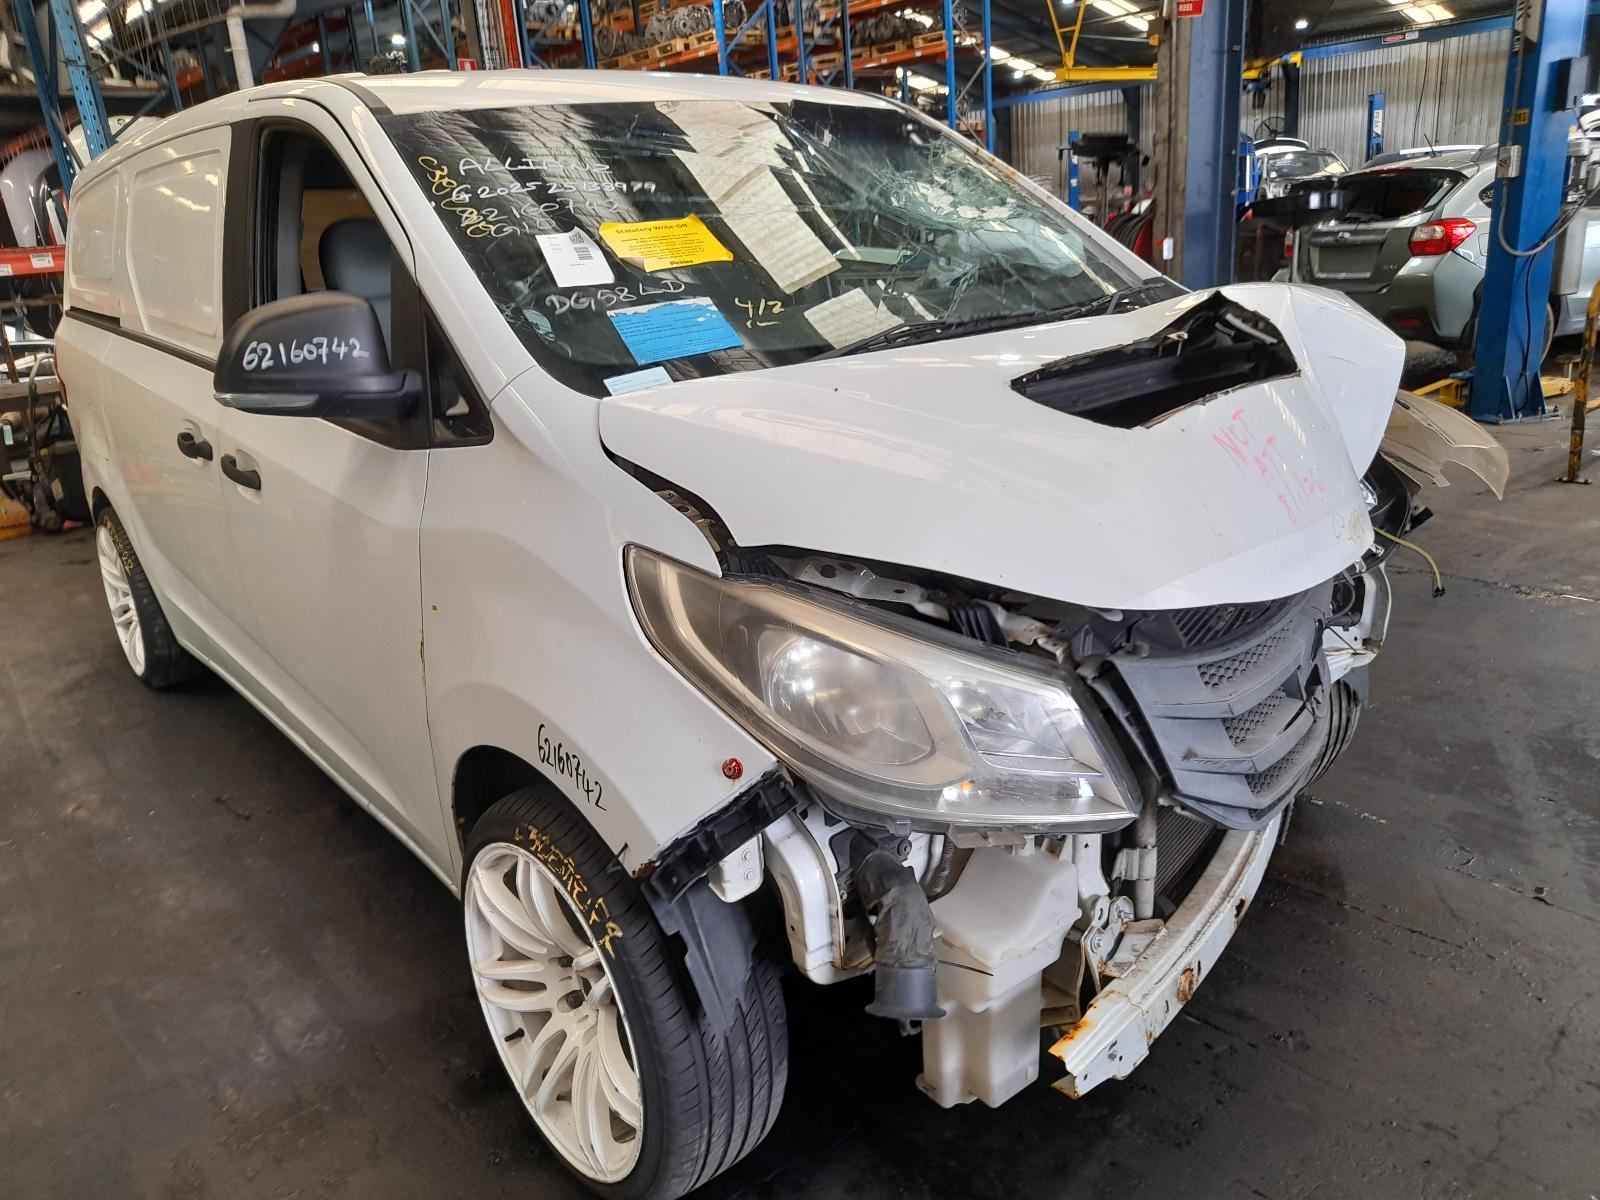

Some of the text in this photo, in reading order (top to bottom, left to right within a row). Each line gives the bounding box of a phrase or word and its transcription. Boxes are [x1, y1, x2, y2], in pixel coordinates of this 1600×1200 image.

[615, 225, 652, 235] Statutory
[242, 336, 370, 372] 62160742
[536, 722, 608, 812] 62160742
